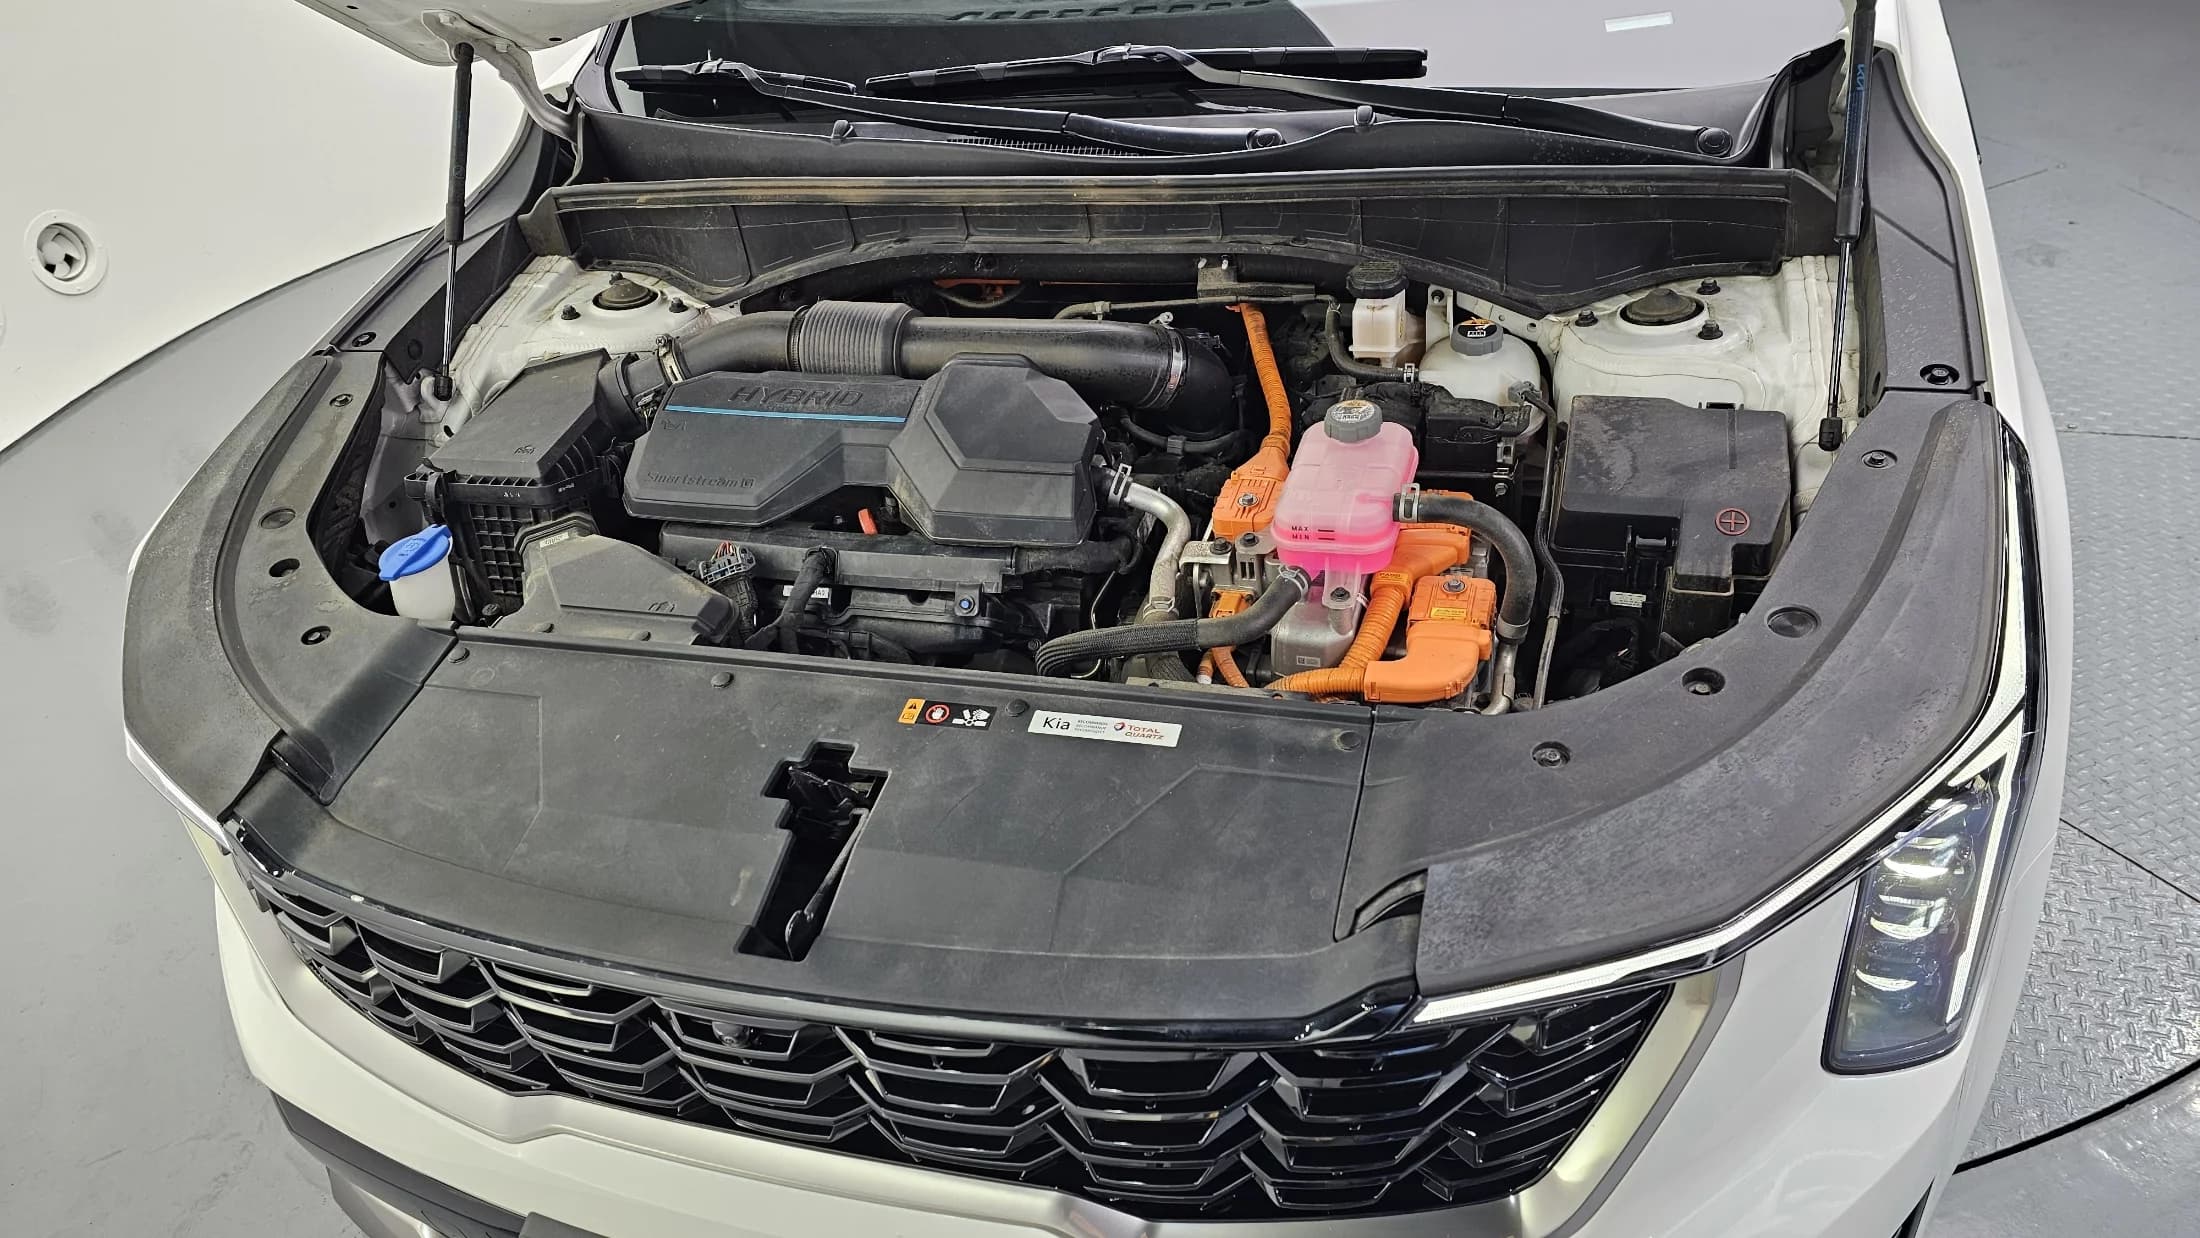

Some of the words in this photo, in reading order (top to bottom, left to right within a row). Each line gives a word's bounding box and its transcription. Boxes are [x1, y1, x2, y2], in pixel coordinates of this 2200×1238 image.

[728, 385, 863, 408] HYBRID
[648, 471, 740, 487] Smartstream
[1043, 717, 1071, 730] Kia
[1128, 725, 1160, 734] TOTAL
[1125, 731, 1164, 740] QUARTZ
